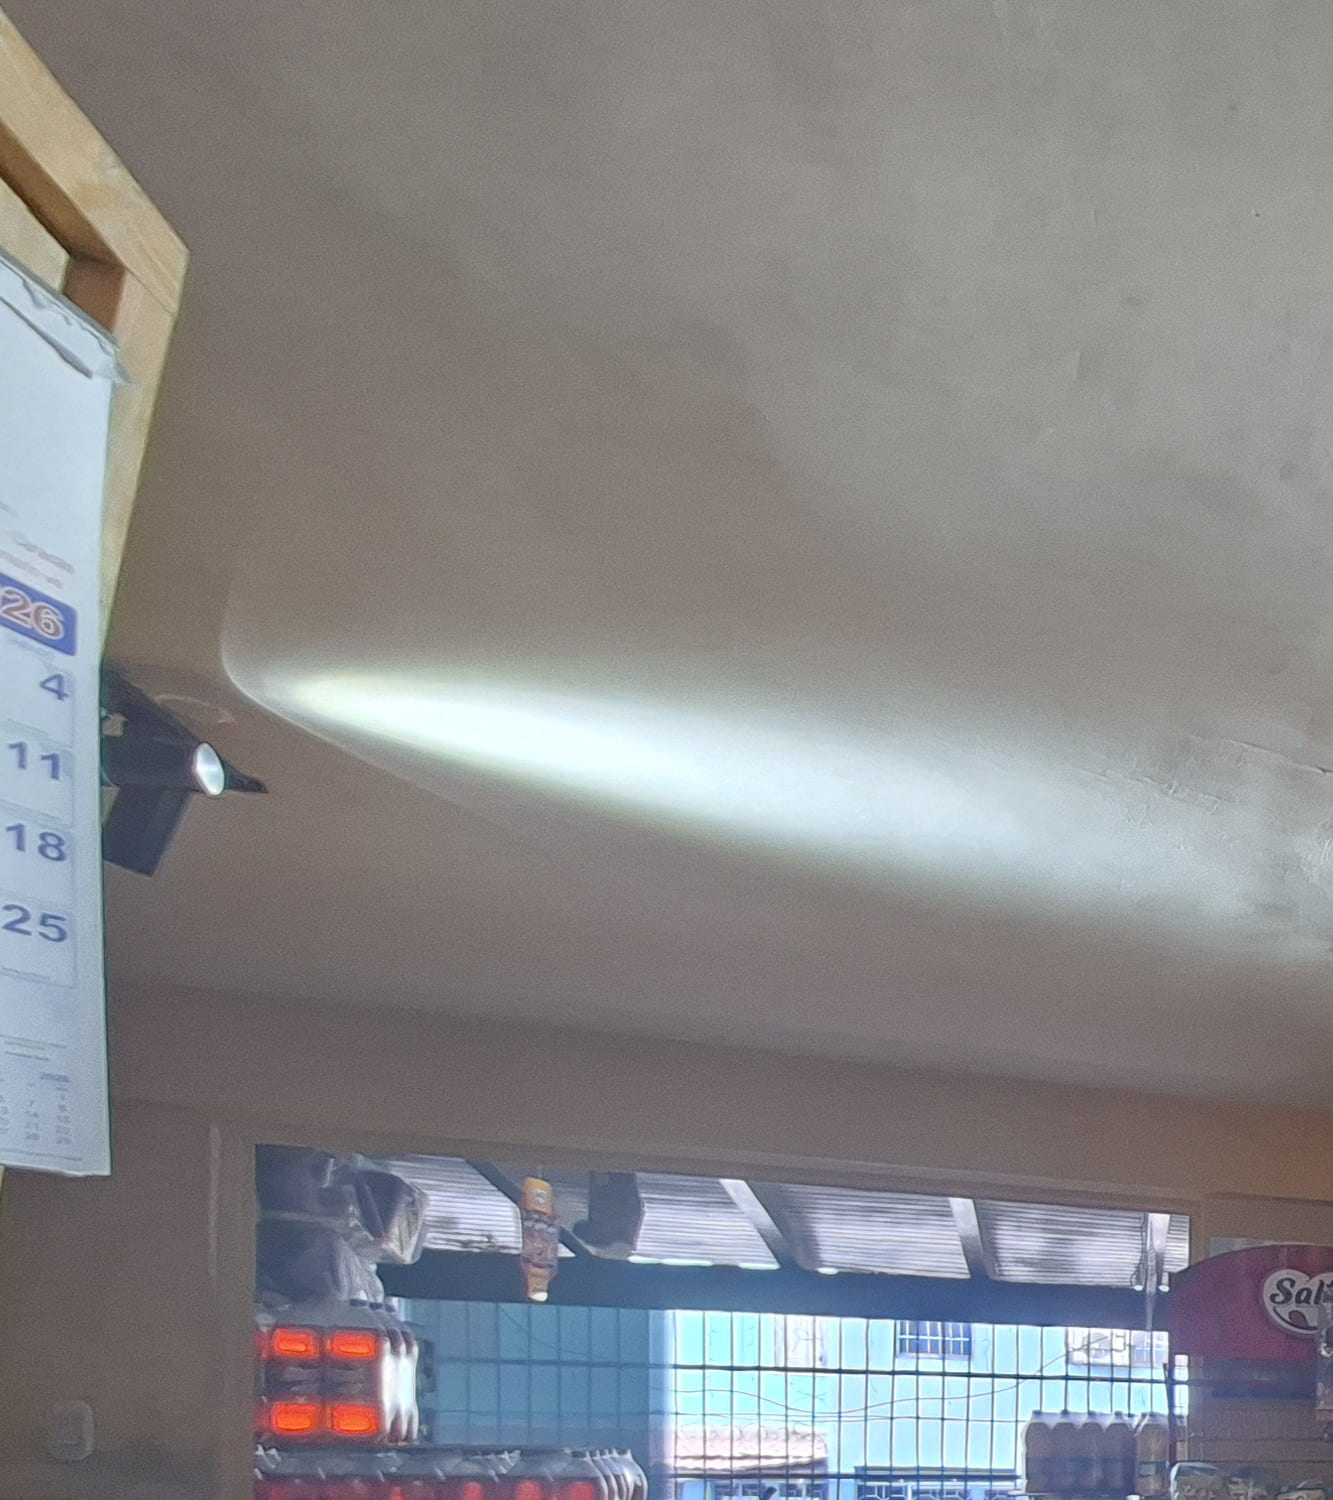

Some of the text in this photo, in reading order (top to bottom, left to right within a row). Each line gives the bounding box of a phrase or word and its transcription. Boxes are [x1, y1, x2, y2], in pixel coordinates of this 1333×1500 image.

[39, 673, 69, 701] 4
[8, 741, 61, 780] 11
[6, 823, 67, 862] 18
[2, 904, 68, 942] 25
